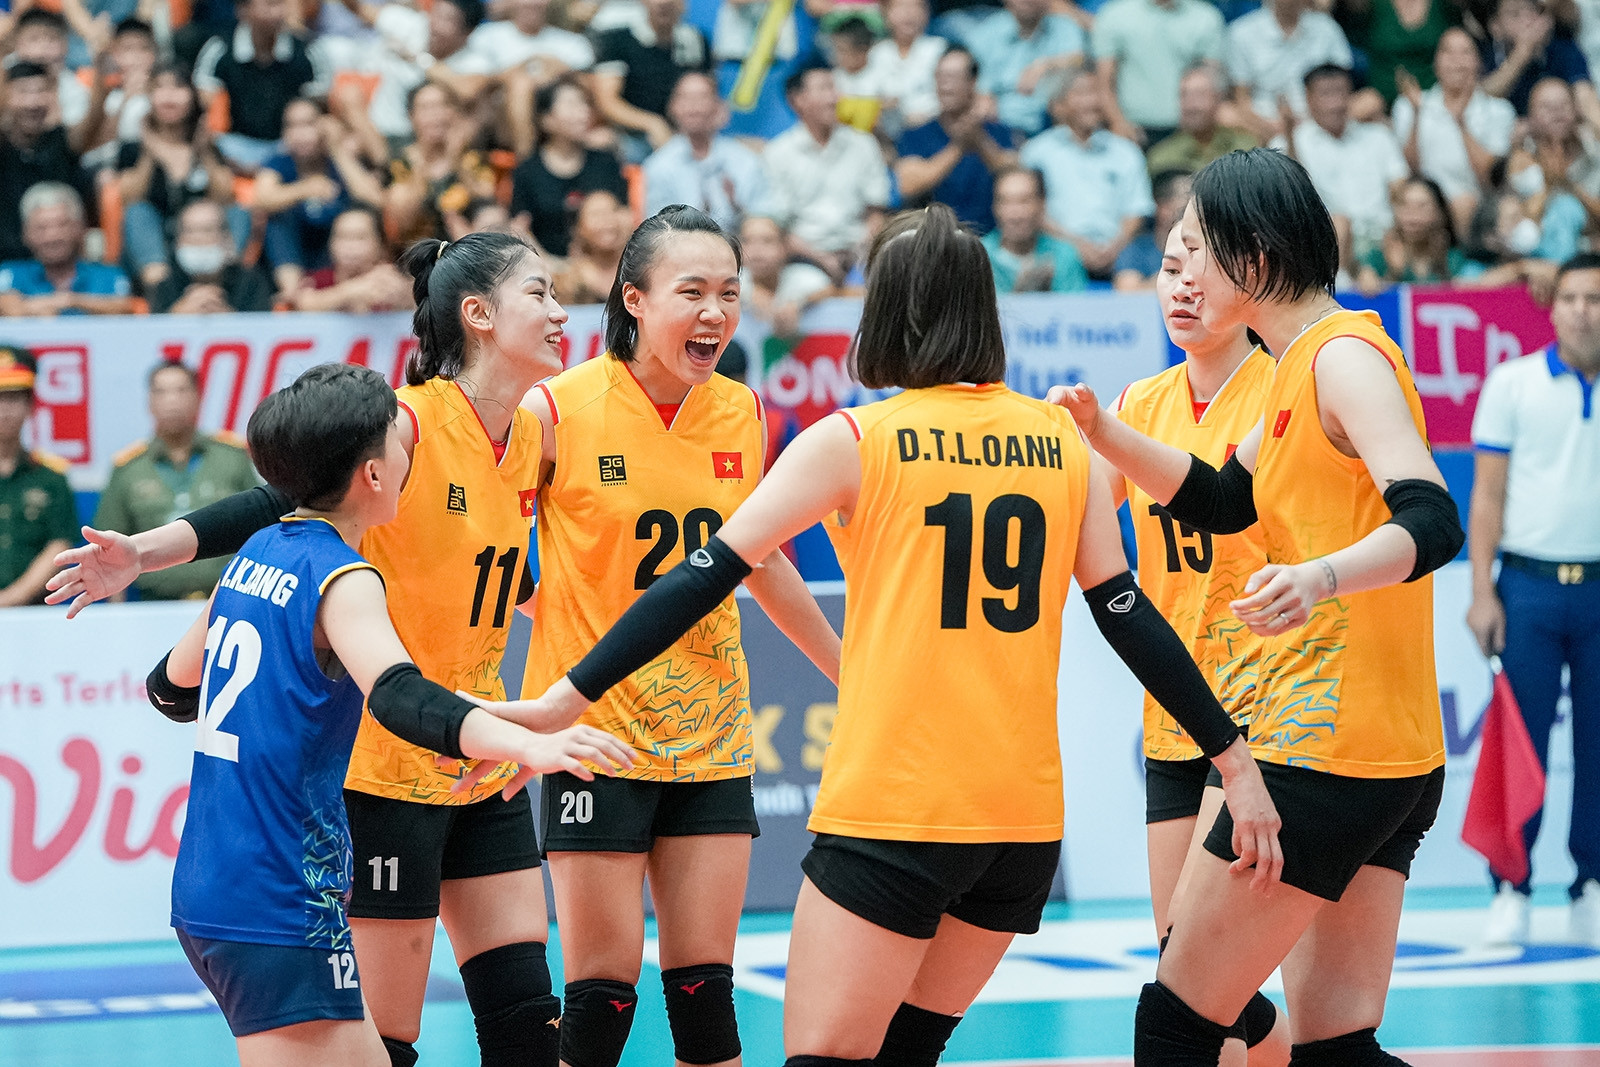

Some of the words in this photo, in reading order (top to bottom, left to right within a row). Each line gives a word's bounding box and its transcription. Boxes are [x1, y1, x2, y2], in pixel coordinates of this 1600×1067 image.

[897, 428, 1063, 470] D.T.L.OANH
[634, 507, 723, 590] 20
[924, 492, 1046, 633] 19
[1148, 502, 1213, 574] 15
[470, 546, 519, 628] 11
[194, 615, 262, 763] 12
[560, 790, 594, 824] 20
[368, 856, 398, 891] 11
[328, 953, 358, 990] 12
